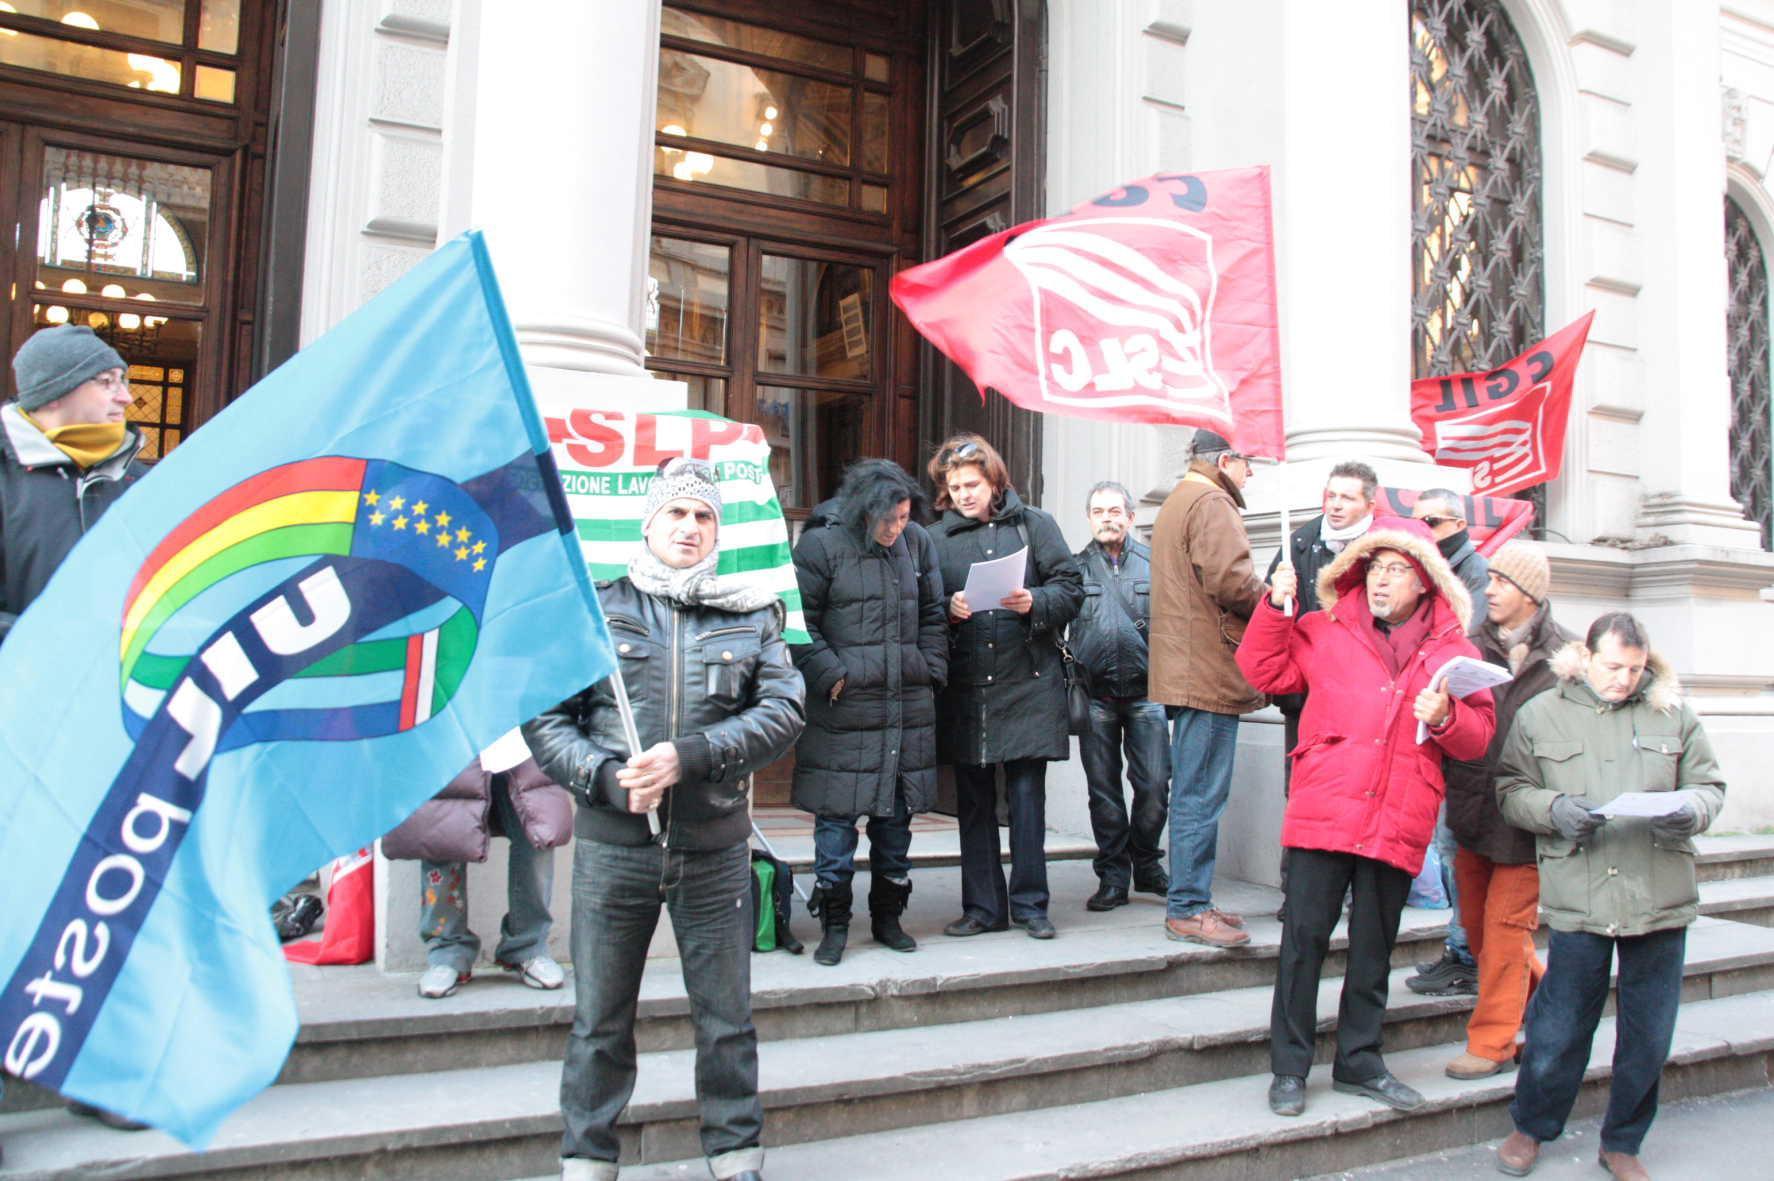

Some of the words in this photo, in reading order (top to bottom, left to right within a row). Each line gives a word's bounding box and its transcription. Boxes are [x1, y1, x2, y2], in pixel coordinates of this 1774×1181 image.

[562, 475, 610, 494] ZIONE
[617, 474, 652, 494] LAV
[725, 462, 762, 485] POST
